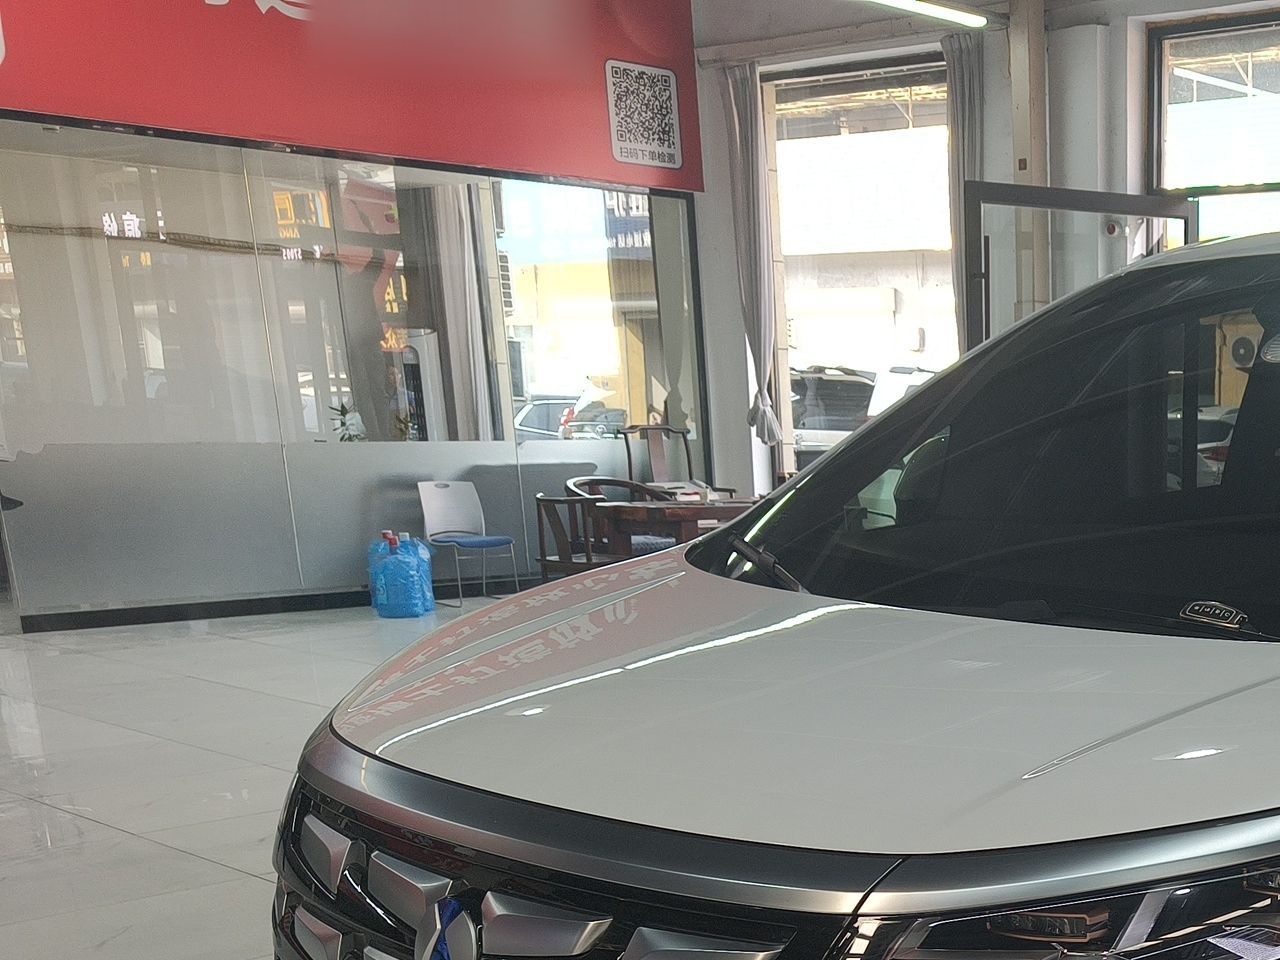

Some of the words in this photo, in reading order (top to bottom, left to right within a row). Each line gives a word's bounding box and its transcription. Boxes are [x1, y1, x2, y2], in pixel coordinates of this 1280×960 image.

[619, 146, 676, 164] 扫码下单检测
